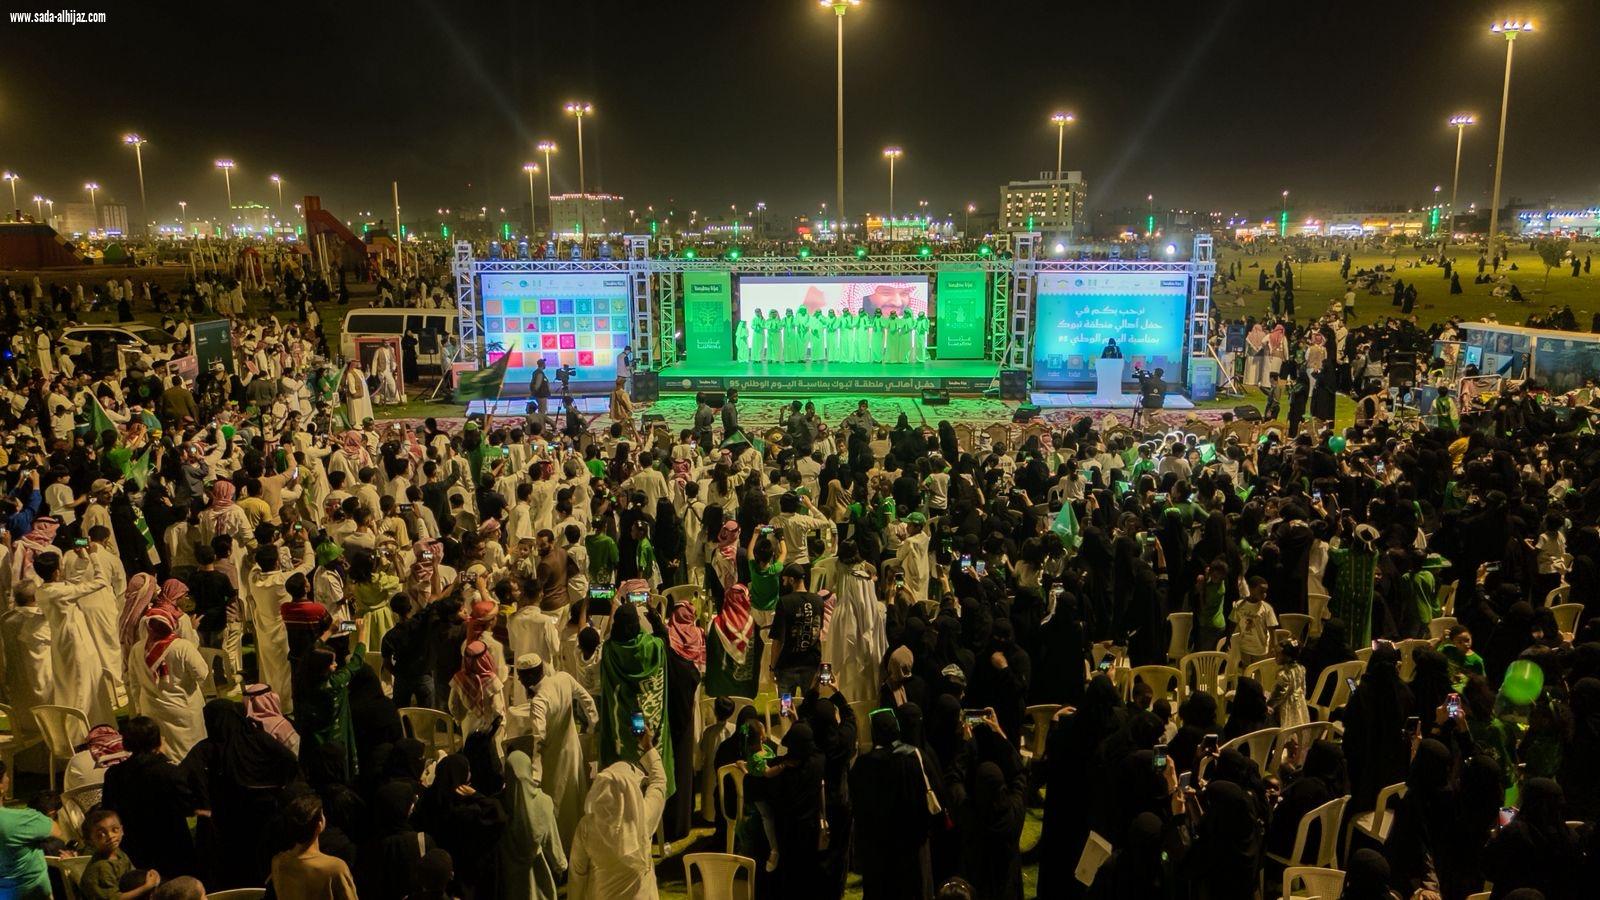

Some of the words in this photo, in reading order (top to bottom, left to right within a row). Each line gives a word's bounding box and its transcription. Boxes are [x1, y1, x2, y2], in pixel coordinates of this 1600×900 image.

[1075, 305, 1090, 317] في
[729, 380, 740, 388] 95
[741, 380, 769, 391] الوطني
[771, 380, 797, 390] اليوم
